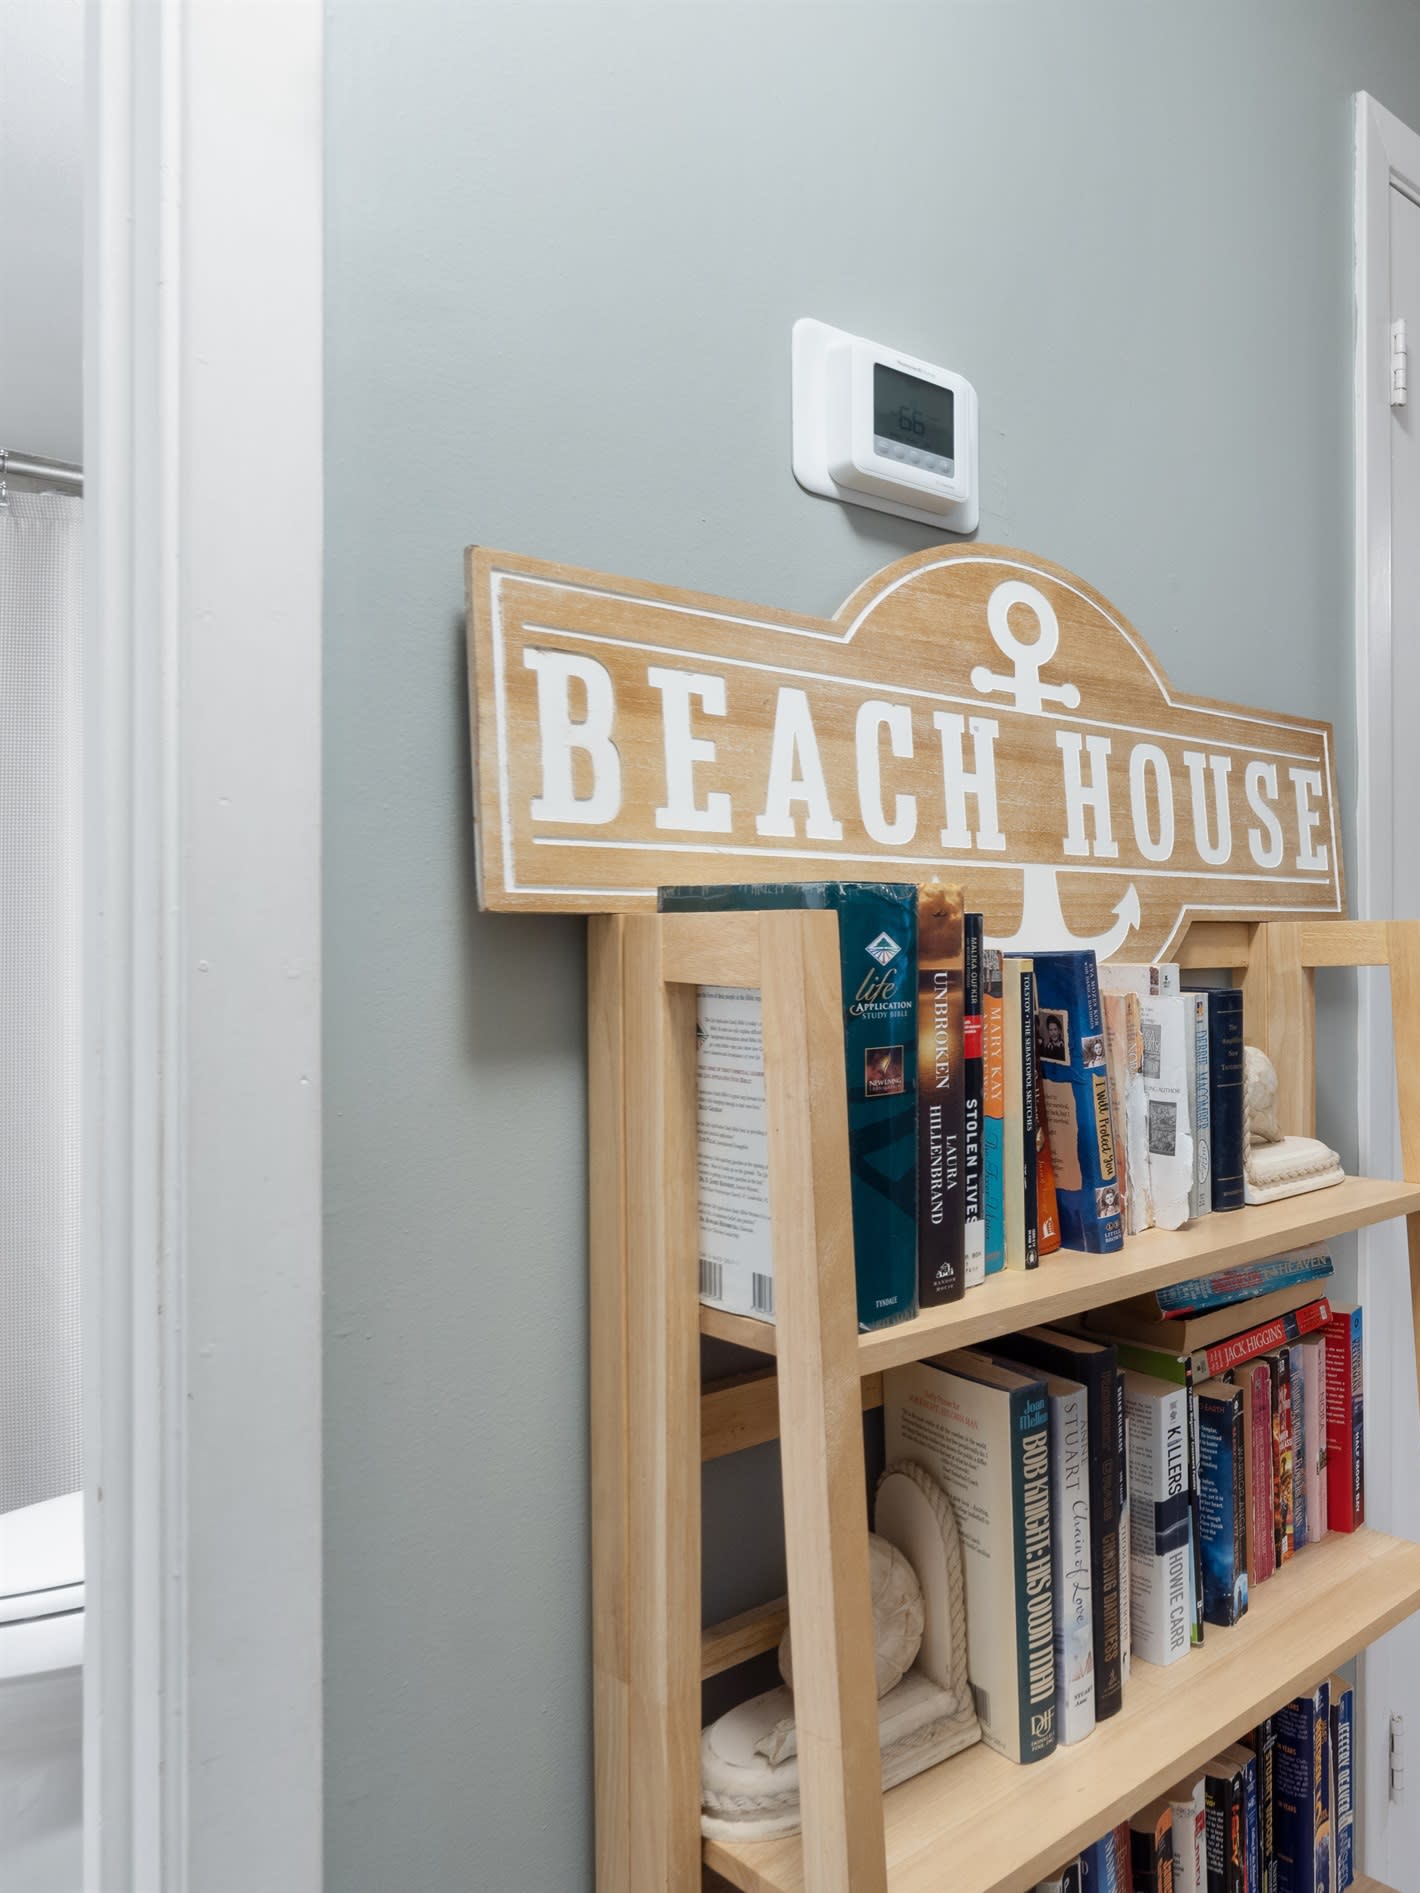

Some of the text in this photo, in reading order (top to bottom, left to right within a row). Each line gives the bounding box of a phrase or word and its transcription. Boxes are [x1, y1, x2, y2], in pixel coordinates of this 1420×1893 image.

[524, 646, 1328, 870] BEACH HOUSE
[856, 968, 897, 1003] life
[970, 937, 978, 1004] MALIKA OUFKIR
[1023, 975, 1031, 1015] TOLSTOY
[850, 1001, 912, 1016] APPLICATION
[862, 1010, 908, 1020] STUDY BIBLE
[933, 972, 950, 1089] UNBROKEN
[991, 1008, 1002, 1102] MARY KAY
[1196, 1031, 1208, 1064] DEBBIE
[869, 1077, 902, 1087] NEW LIVING
[1096, 1089, 1108, 1113] Will
[1197, 1072, 1209, 1129] MACOMBER
[946, 1134, 957, 1190] LAURA
[966, 1099, 978, 1224] STOLEN LIVES
[1098, 1117, 1111, 1153] Protect
[929, 1105, 944, 1225] HILLENBRAND
[1101, 1154, 1114, 1176] You
[1278, 1256, 1327, 1275] HEAVEN
[876, 1296, 898, 1308] TYNDALE
[1224, 1343, 1245, 1365] JACK
[1247, 1325, 1283, 1356] HIGGINS
[1019, 1412, 1048, 1433] Mellen
[1024, 1398, 1045, 1416] Joan
[1064, 1402, 1080, 1490] STUART
[1081, 1420, 1089, 1466] ANNE
[1167, 1425, 1183, 1497] KILLERS
[1021, 1431, 1054, 1704] BOB KNIGHT: HIS OWN MAN
[1066, 1501, 1090, 1624] Chain of Love
[1102, 1532, 1118, 1663] CHASING DARKNESS
[1120, 1577, 1128, 1641] JEFFERSON
[1168, 1552, 1185, 1651] HOWIE CARR
[1338, 1722, 1350, 1810] JEFFERY DEAVER
